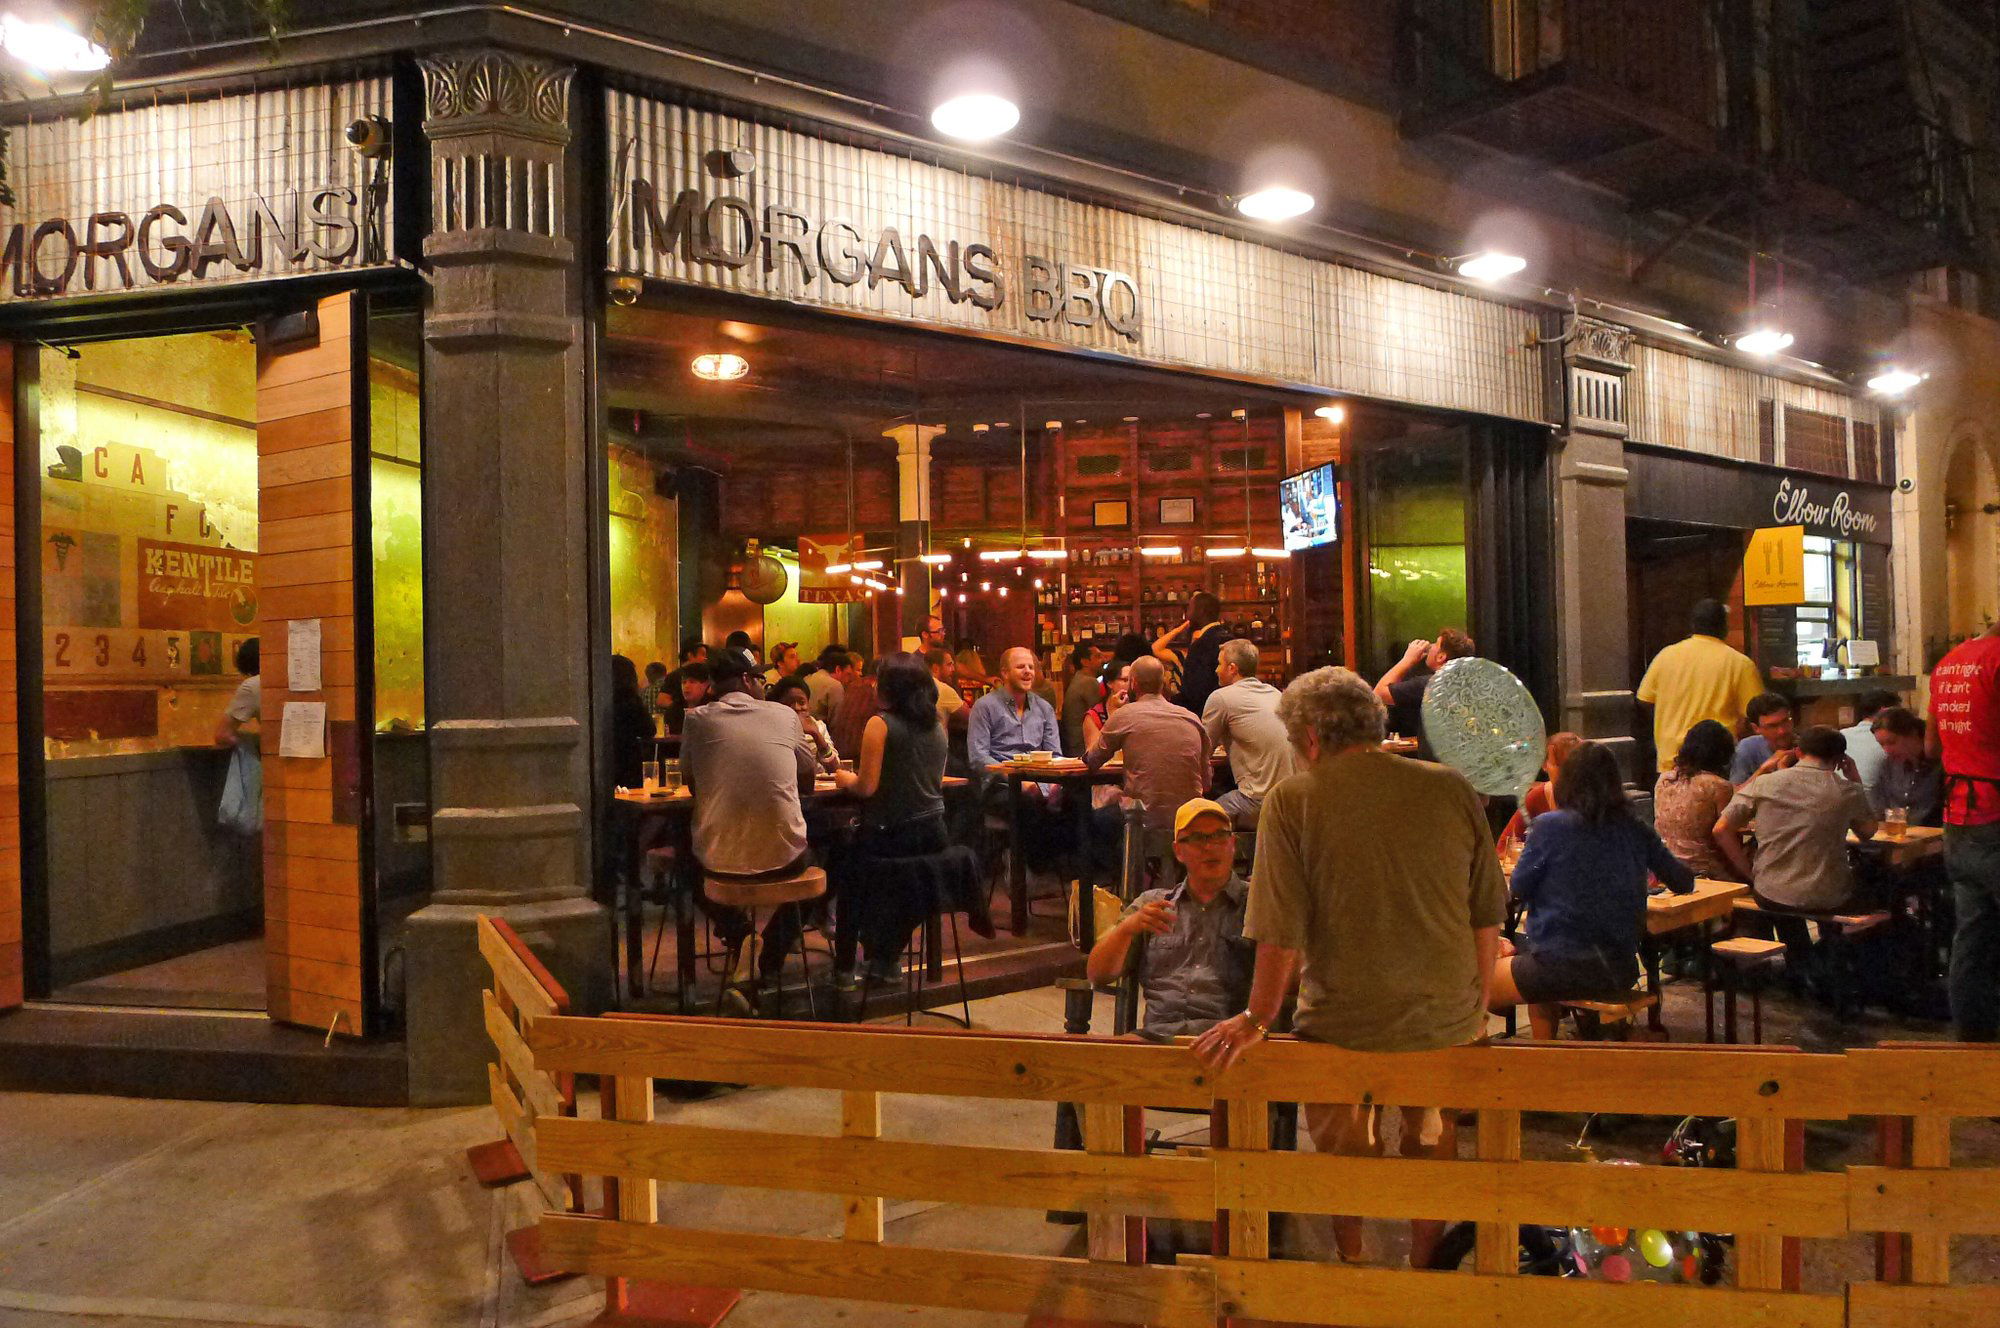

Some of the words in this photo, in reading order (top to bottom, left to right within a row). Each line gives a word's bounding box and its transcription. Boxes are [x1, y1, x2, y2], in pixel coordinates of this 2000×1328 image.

[632, 178, 1004, 311] MORGANS
[1023, 255, 1142, 343] BBQ
[1773, 477, 1829, 525] Elbow
[1830, 492, 1877, 536] Room
[145, 548, 254, 597] KENTILE
[800, 589, 867, 602] TEXAS
[55, 633, 71, 667] 2
[95, 634, 110, 667] 3
[132, 636, 146, 668] 4
[1937, 700, 1971, 713] smoked
